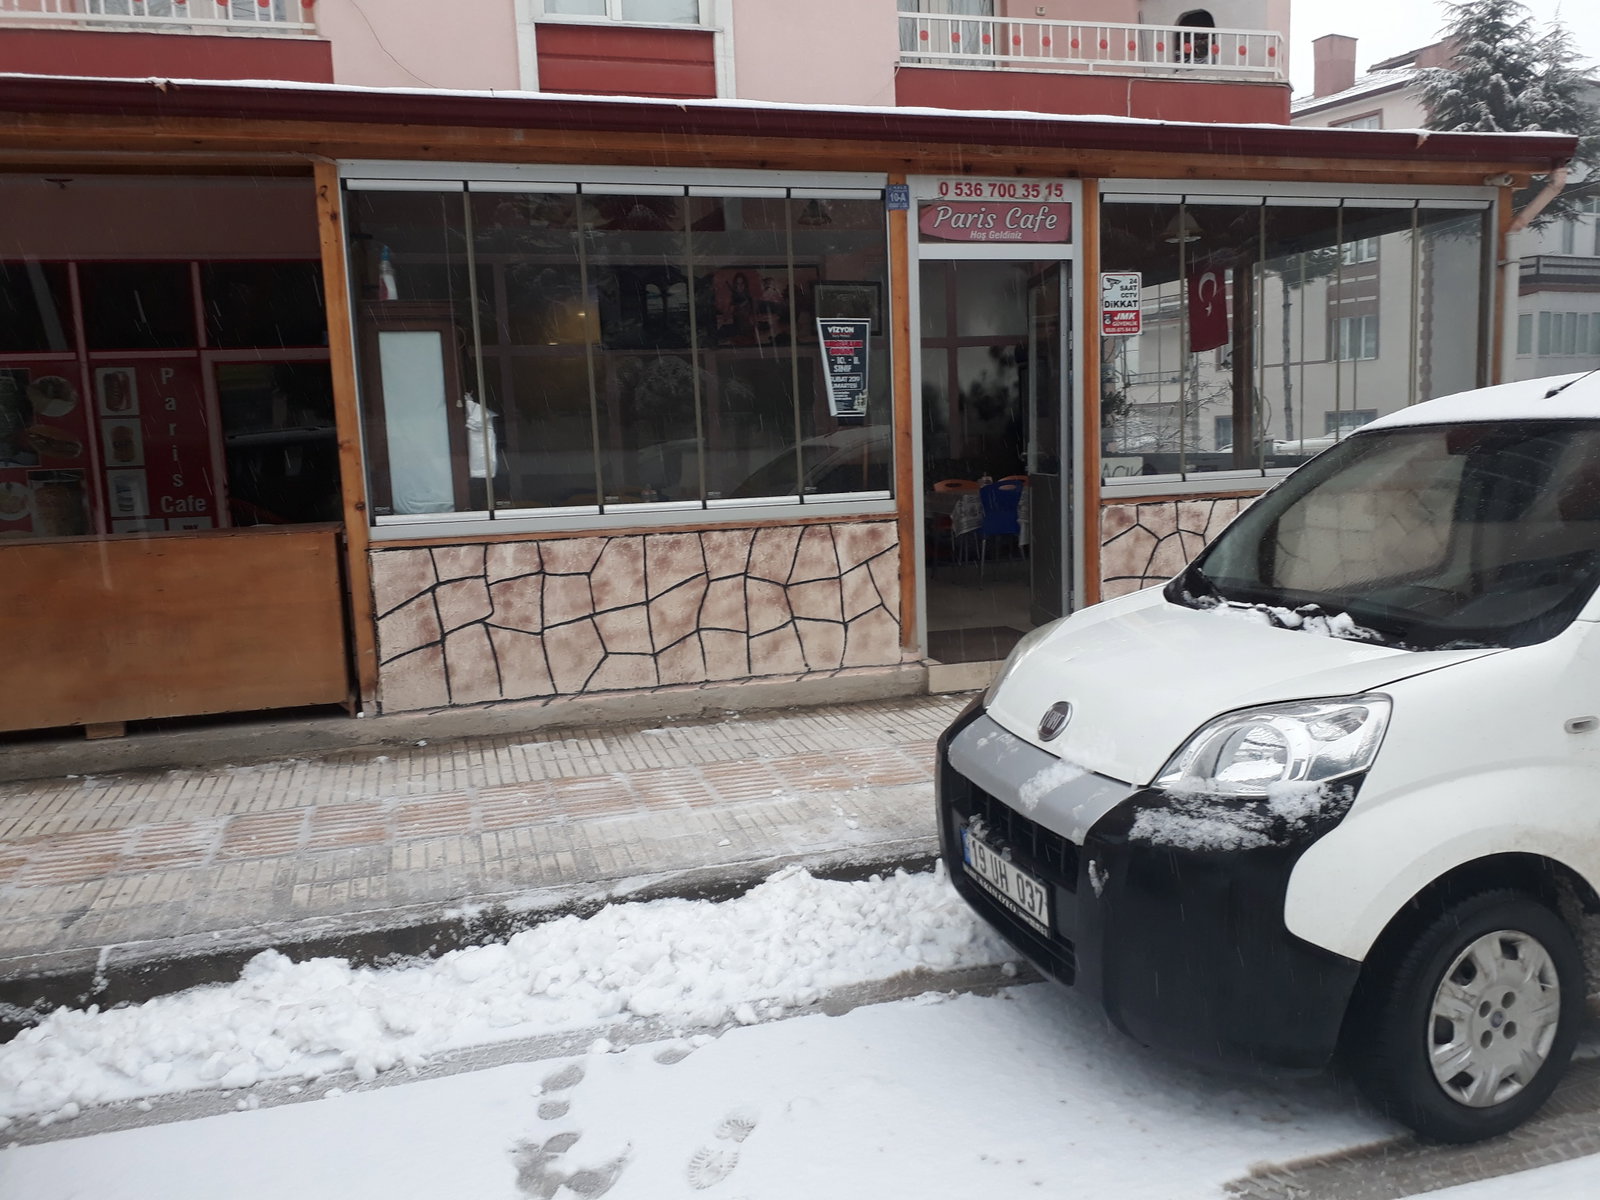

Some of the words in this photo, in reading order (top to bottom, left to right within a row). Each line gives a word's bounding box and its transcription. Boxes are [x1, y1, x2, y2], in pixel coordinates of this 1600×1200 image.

[939, 181, 949, 197] 0
[954, 182, 983, 197] 536
[988, 183, 1017, 198] 700
[1022, 183, 1041, 198] 35
[1045, 183, 1064, 198] 15
[933, 205, 997, 229] Paris
[1005, 206, 1058, 233] Cafe
[969, 230, 987, 240] Hoş
[988, 230, 1022, 240] Geldiniz
[1113, 312, 1137, 320] JMK
[160, 495, 207, 513] Cafe
[972, 840, 987, 874] 19
[990, 854, 1009, 893] UH
[1016, 873, 1043, 916] 037
